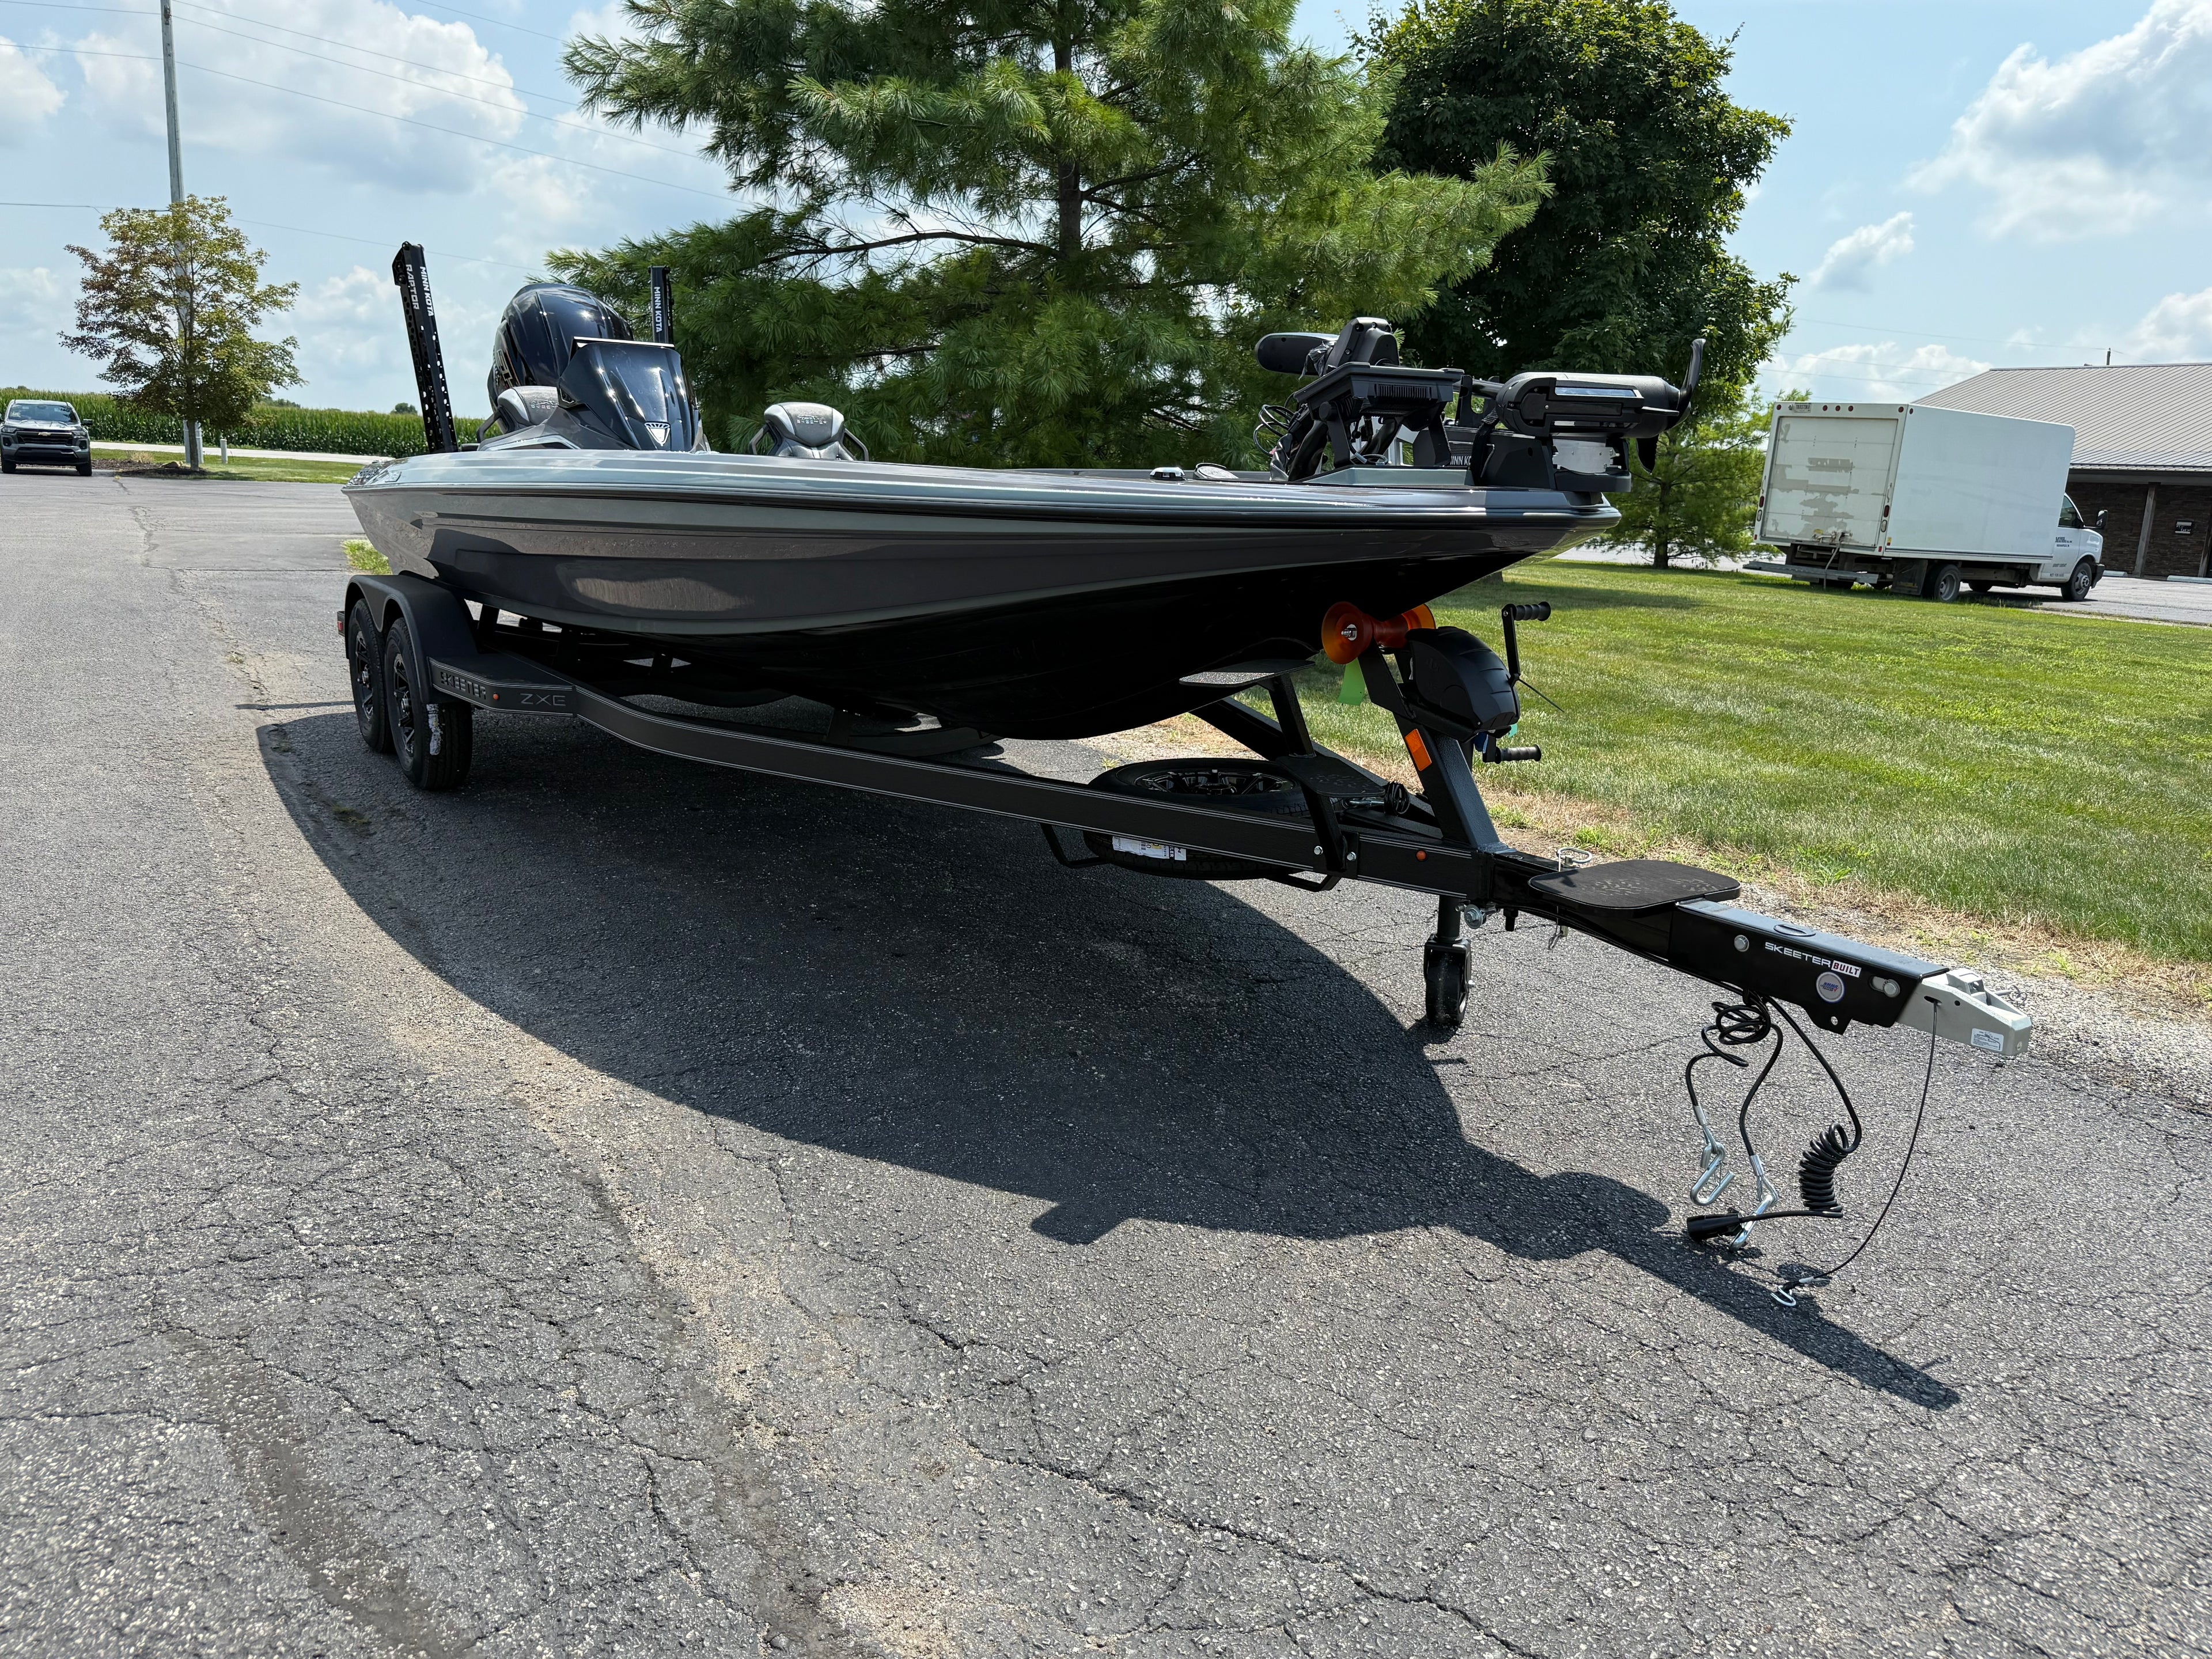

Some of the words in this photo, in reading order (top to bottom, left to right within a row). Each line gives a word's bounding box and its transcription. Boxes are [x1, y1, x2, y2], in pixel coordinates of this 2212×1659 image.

[406, 264, 420, 310] RAPTOR
[420, 266, 430, 291] MINN
[425, 292, 434, 317] KOTA
[1450, 455, 1463, 465] INN
[440, 671, 487, 700] SKEETER
[520, 693, 566, 706] ZXE
[1764, 941, 1832, 968] SKEETER
[1832, 962, 1861, 976] BUILT
